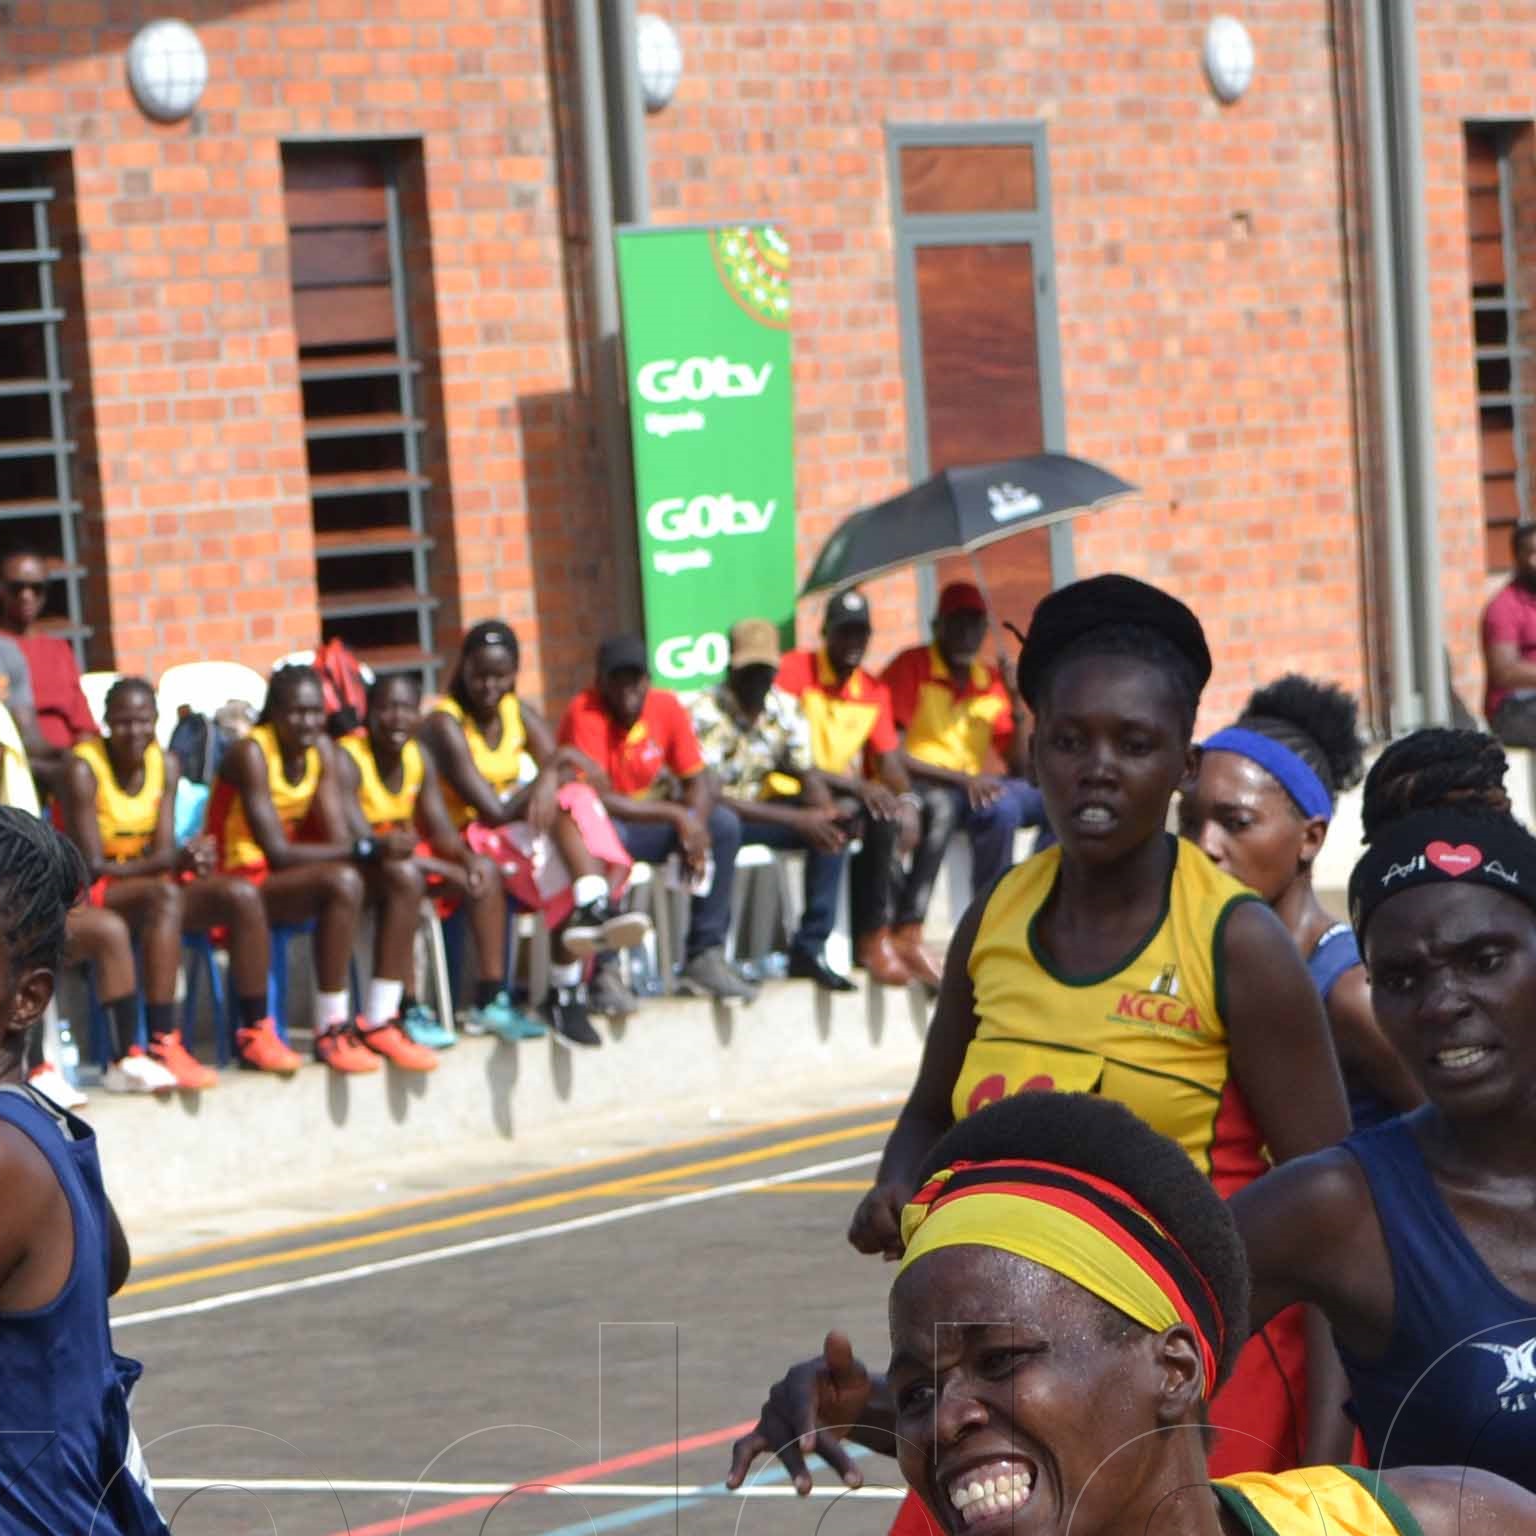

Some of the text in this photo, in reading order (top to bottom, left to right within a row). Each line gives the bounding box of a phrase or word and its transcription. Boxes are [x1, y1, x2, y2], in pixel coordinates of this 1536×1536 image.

[636, 355, 775, 403] GOtv
[646, 493, 778, 542] GOtv
[653, 632, 730, 680] GO
[1116, 993, 1203, 1032] KCCA
